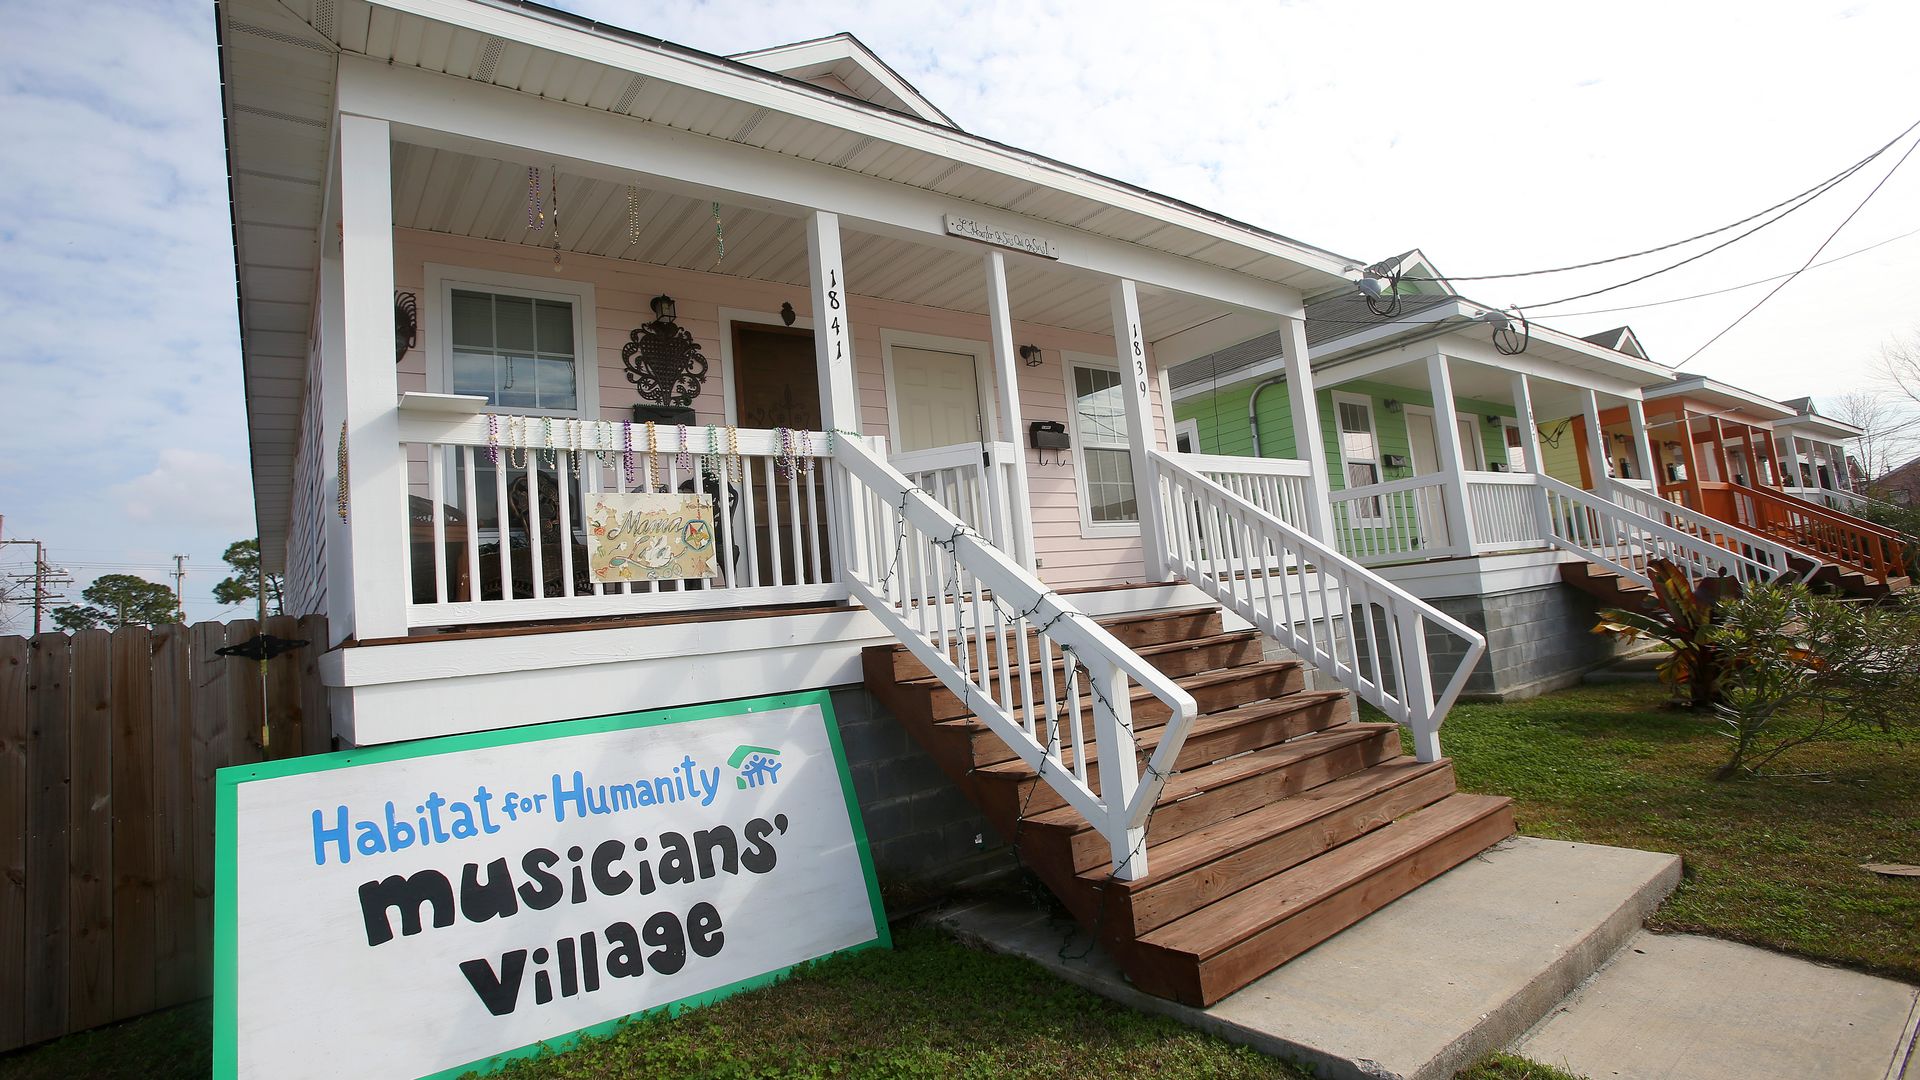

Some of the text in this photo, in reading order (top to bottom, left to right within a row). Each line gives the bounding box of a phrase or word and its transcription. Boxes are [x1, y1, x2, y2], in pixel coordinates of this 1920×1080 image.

[827, 268, 842, 361] 1841
[1133, 323, 1147, 399] 1839
[607, 509, 685, 541] Mama
[310, 755, 721, 866] Habitat for Humanity
